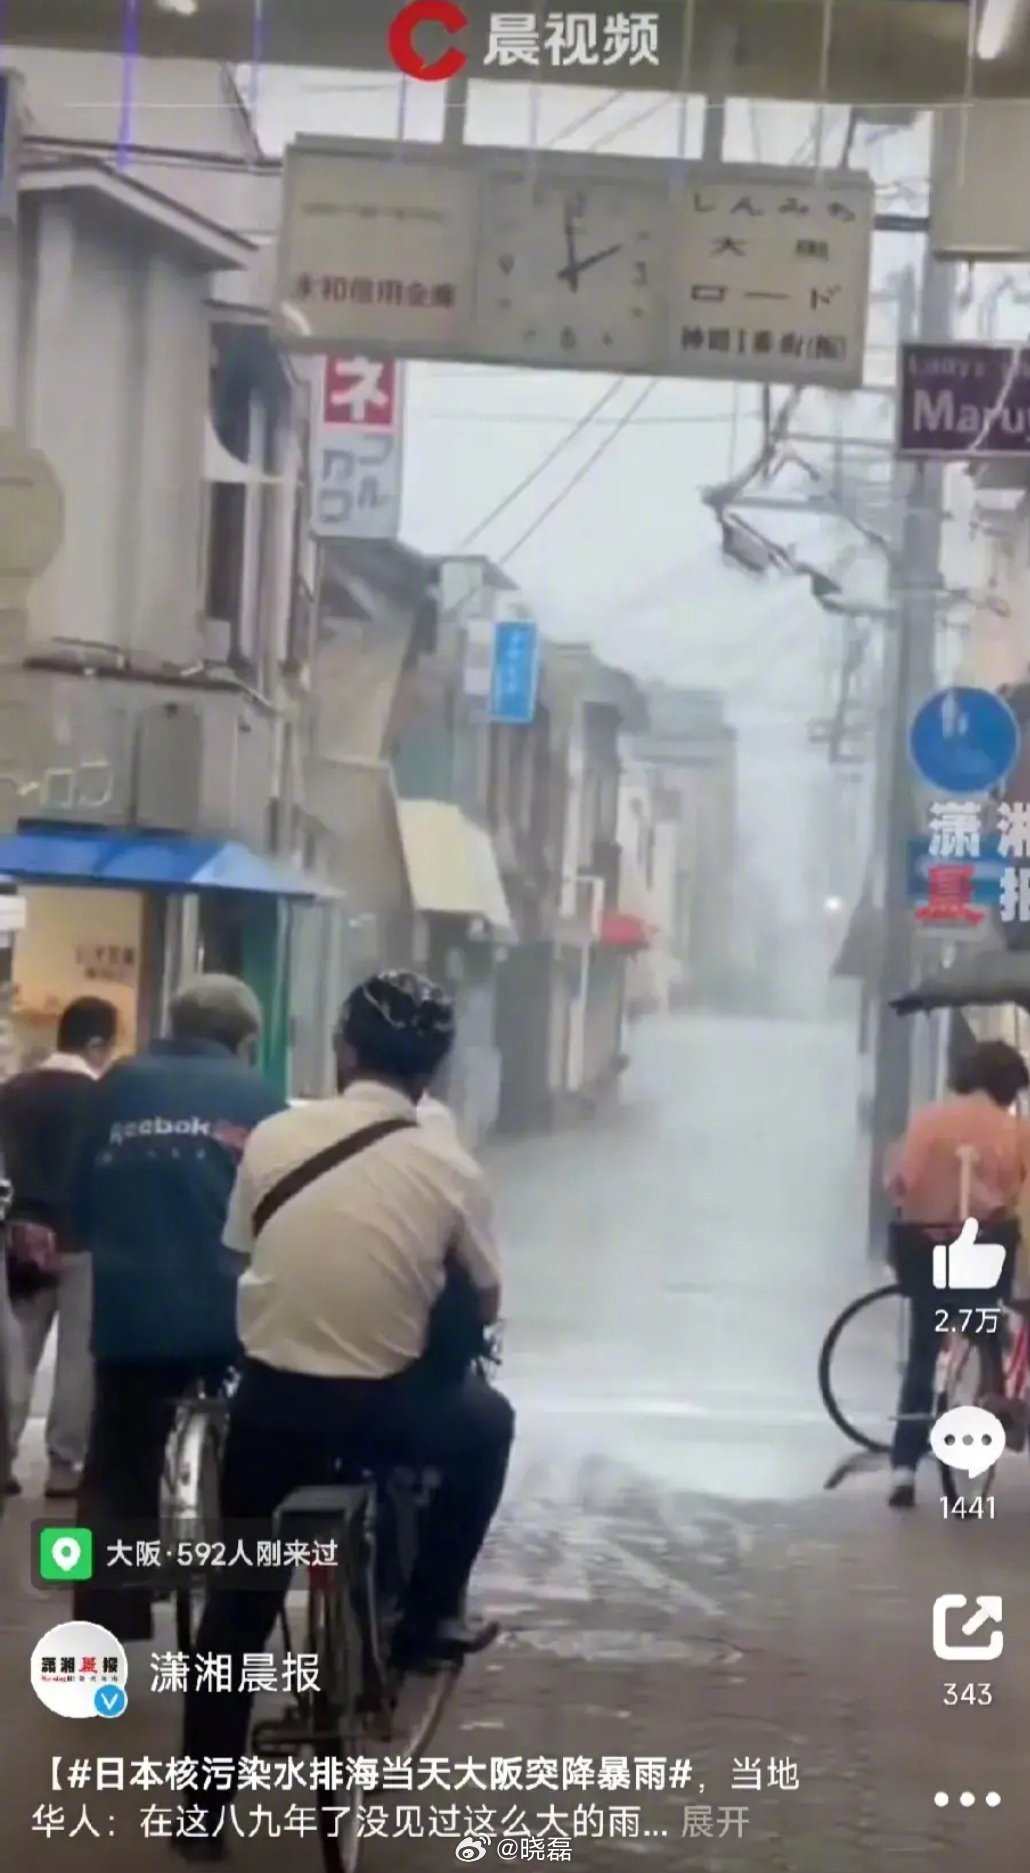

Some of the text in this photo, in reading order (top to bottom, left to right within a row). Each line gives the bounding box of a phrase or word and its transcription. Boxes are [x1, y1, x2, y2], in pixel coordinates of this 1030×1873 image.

[330, 356, 389, 422] ネ
[913, 388, 1030, 444] Maru
[109, 1115, 211, 1146] Reebok
